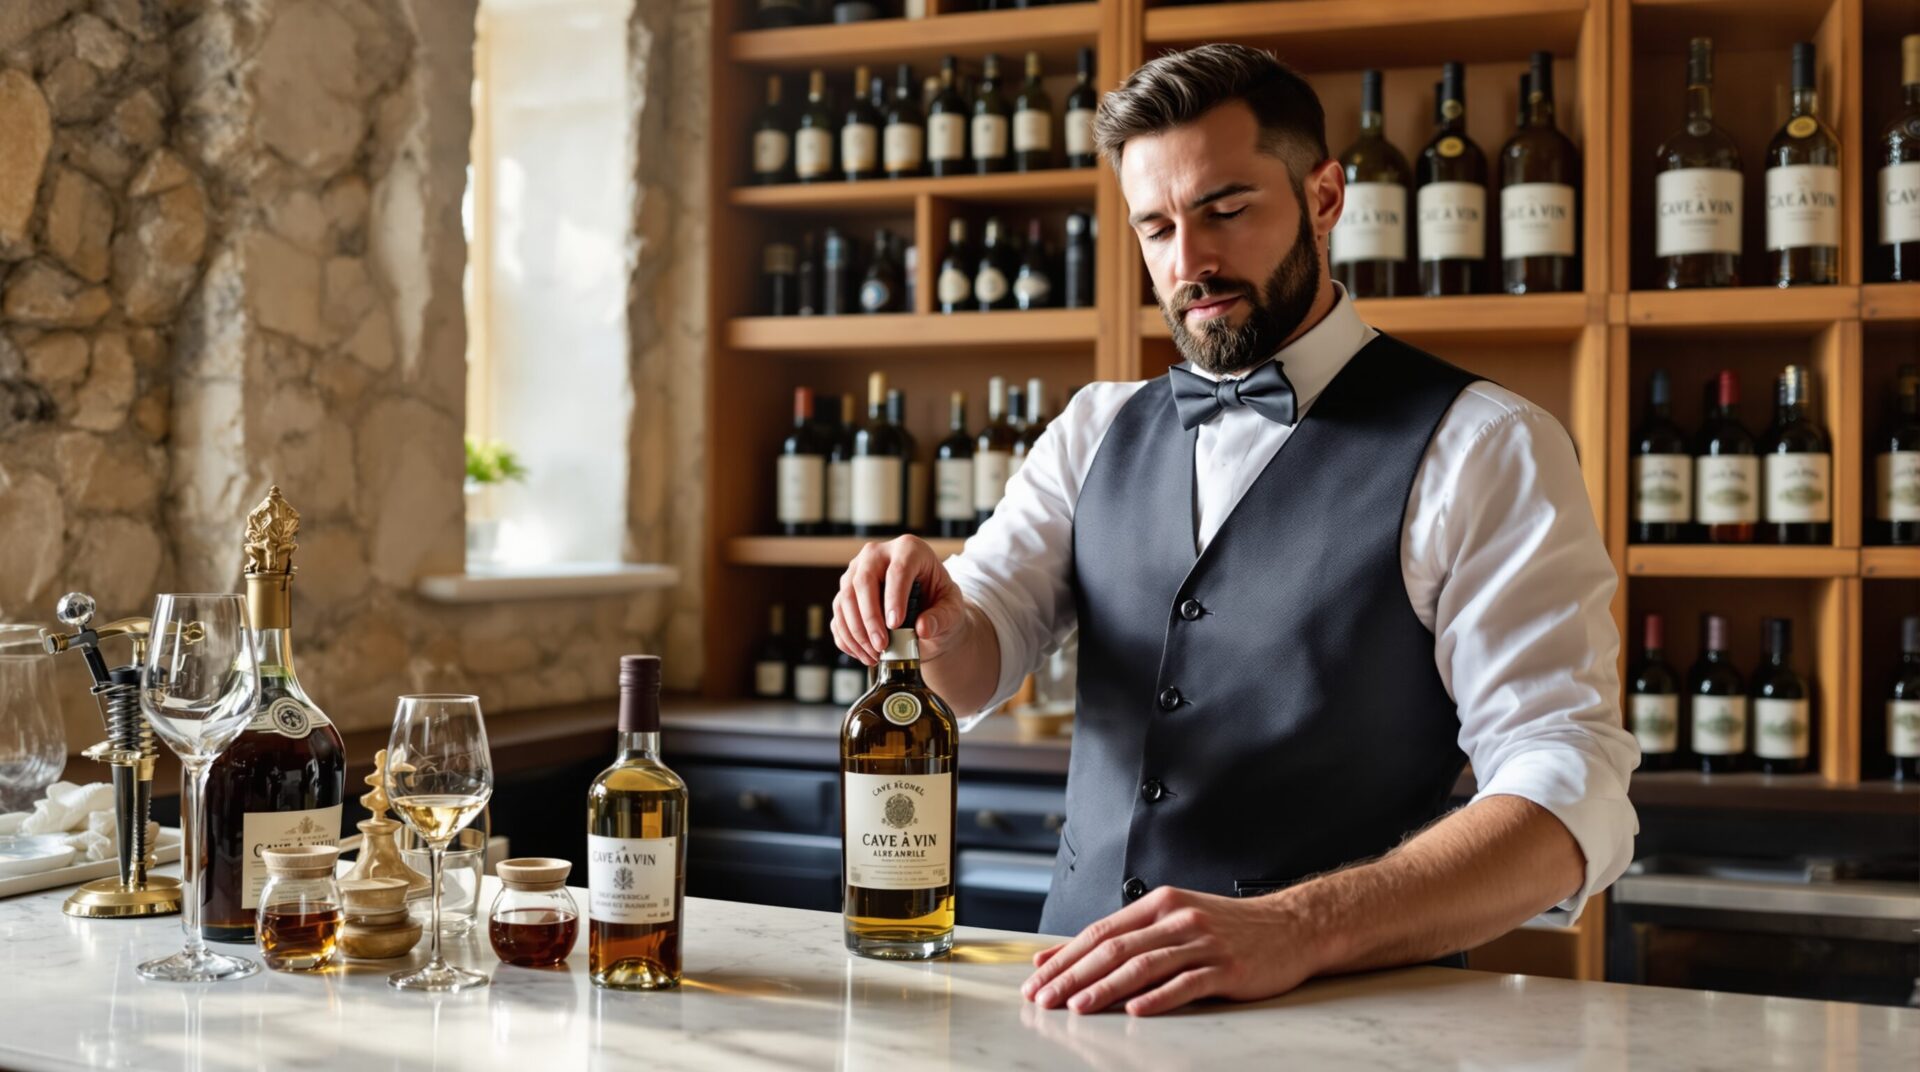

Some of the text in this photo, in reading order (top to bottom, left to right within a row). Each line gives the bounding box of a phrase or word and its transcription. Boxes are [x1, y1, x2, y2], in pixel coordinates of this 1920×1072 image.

[1708, 198, 1733, 215] VIN
[872, 783, 891, 797] CAVE
[862, 833, 897, 847] CAVE
[913, 833, 937, 847] VIN
[632, 853, 656, 867] VIN
